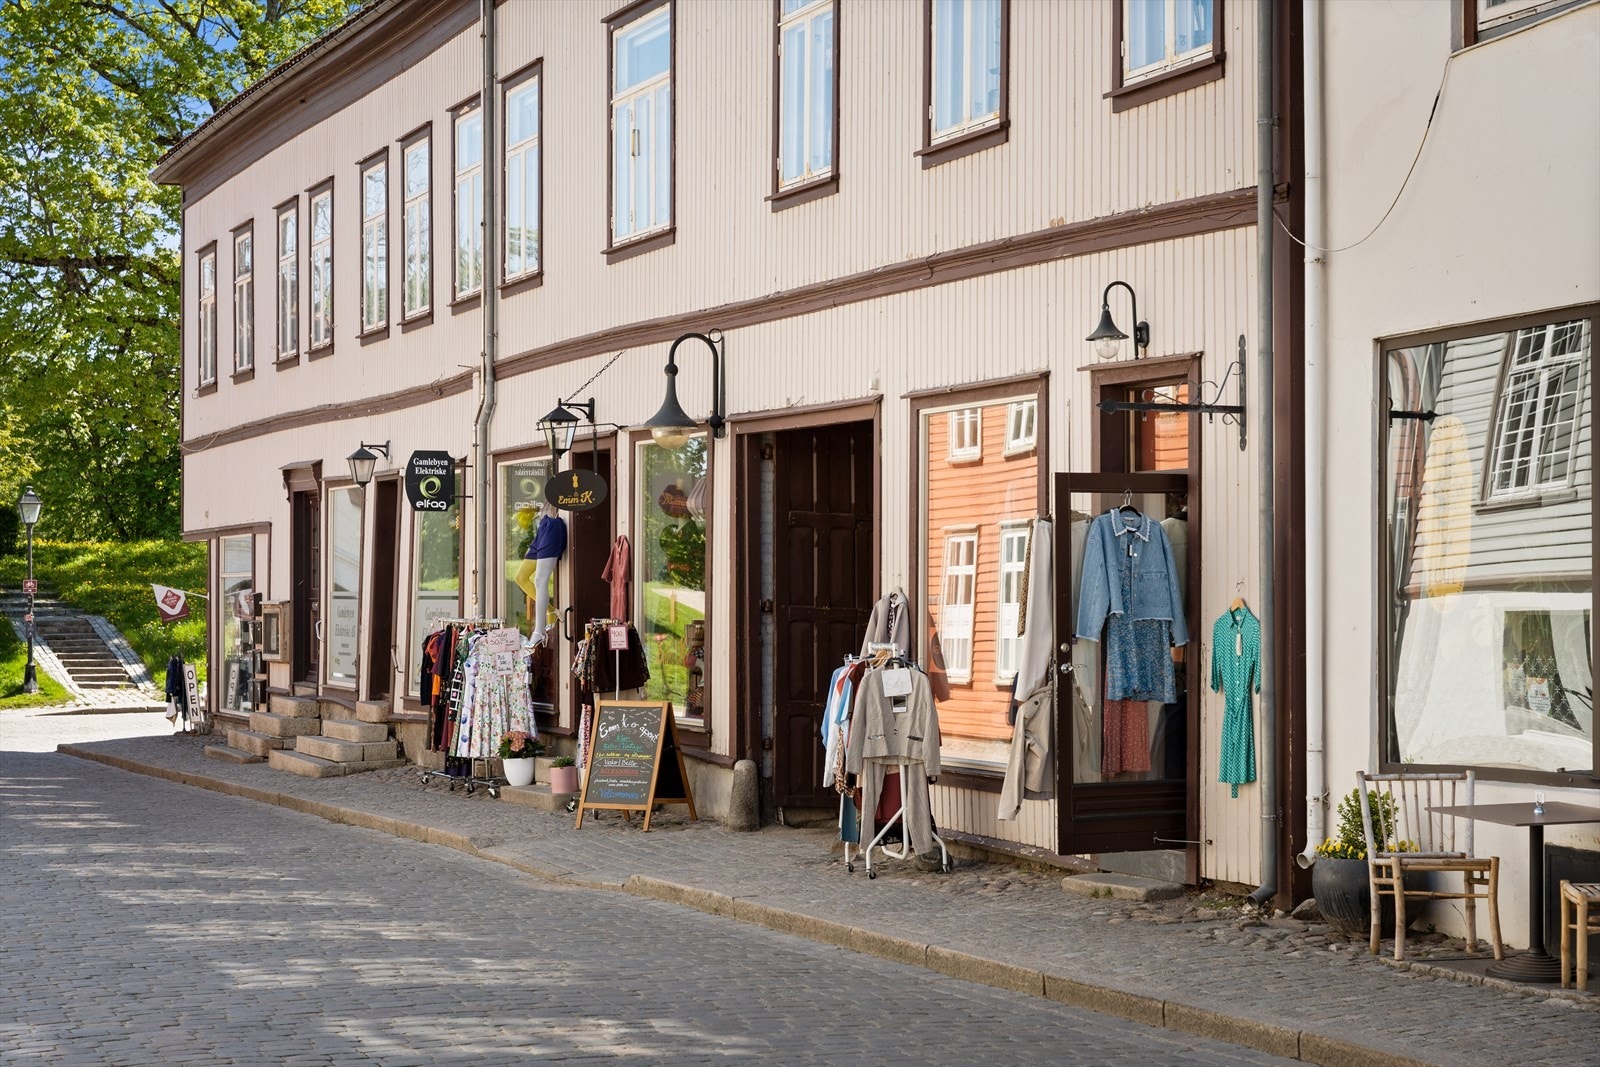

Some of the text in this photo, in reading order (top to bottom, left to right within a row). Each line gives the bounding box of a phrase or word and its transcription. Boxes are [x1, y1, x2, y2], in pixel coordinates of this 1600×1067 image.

[413, 457, 449, 467] Gamlebyen
[415, 467, 447, 475] Elektriske
[558, 490, 593, 504] Emm K
[416, 499, 447, 510] elfag
[187, 670, 199, 717] OPEN
